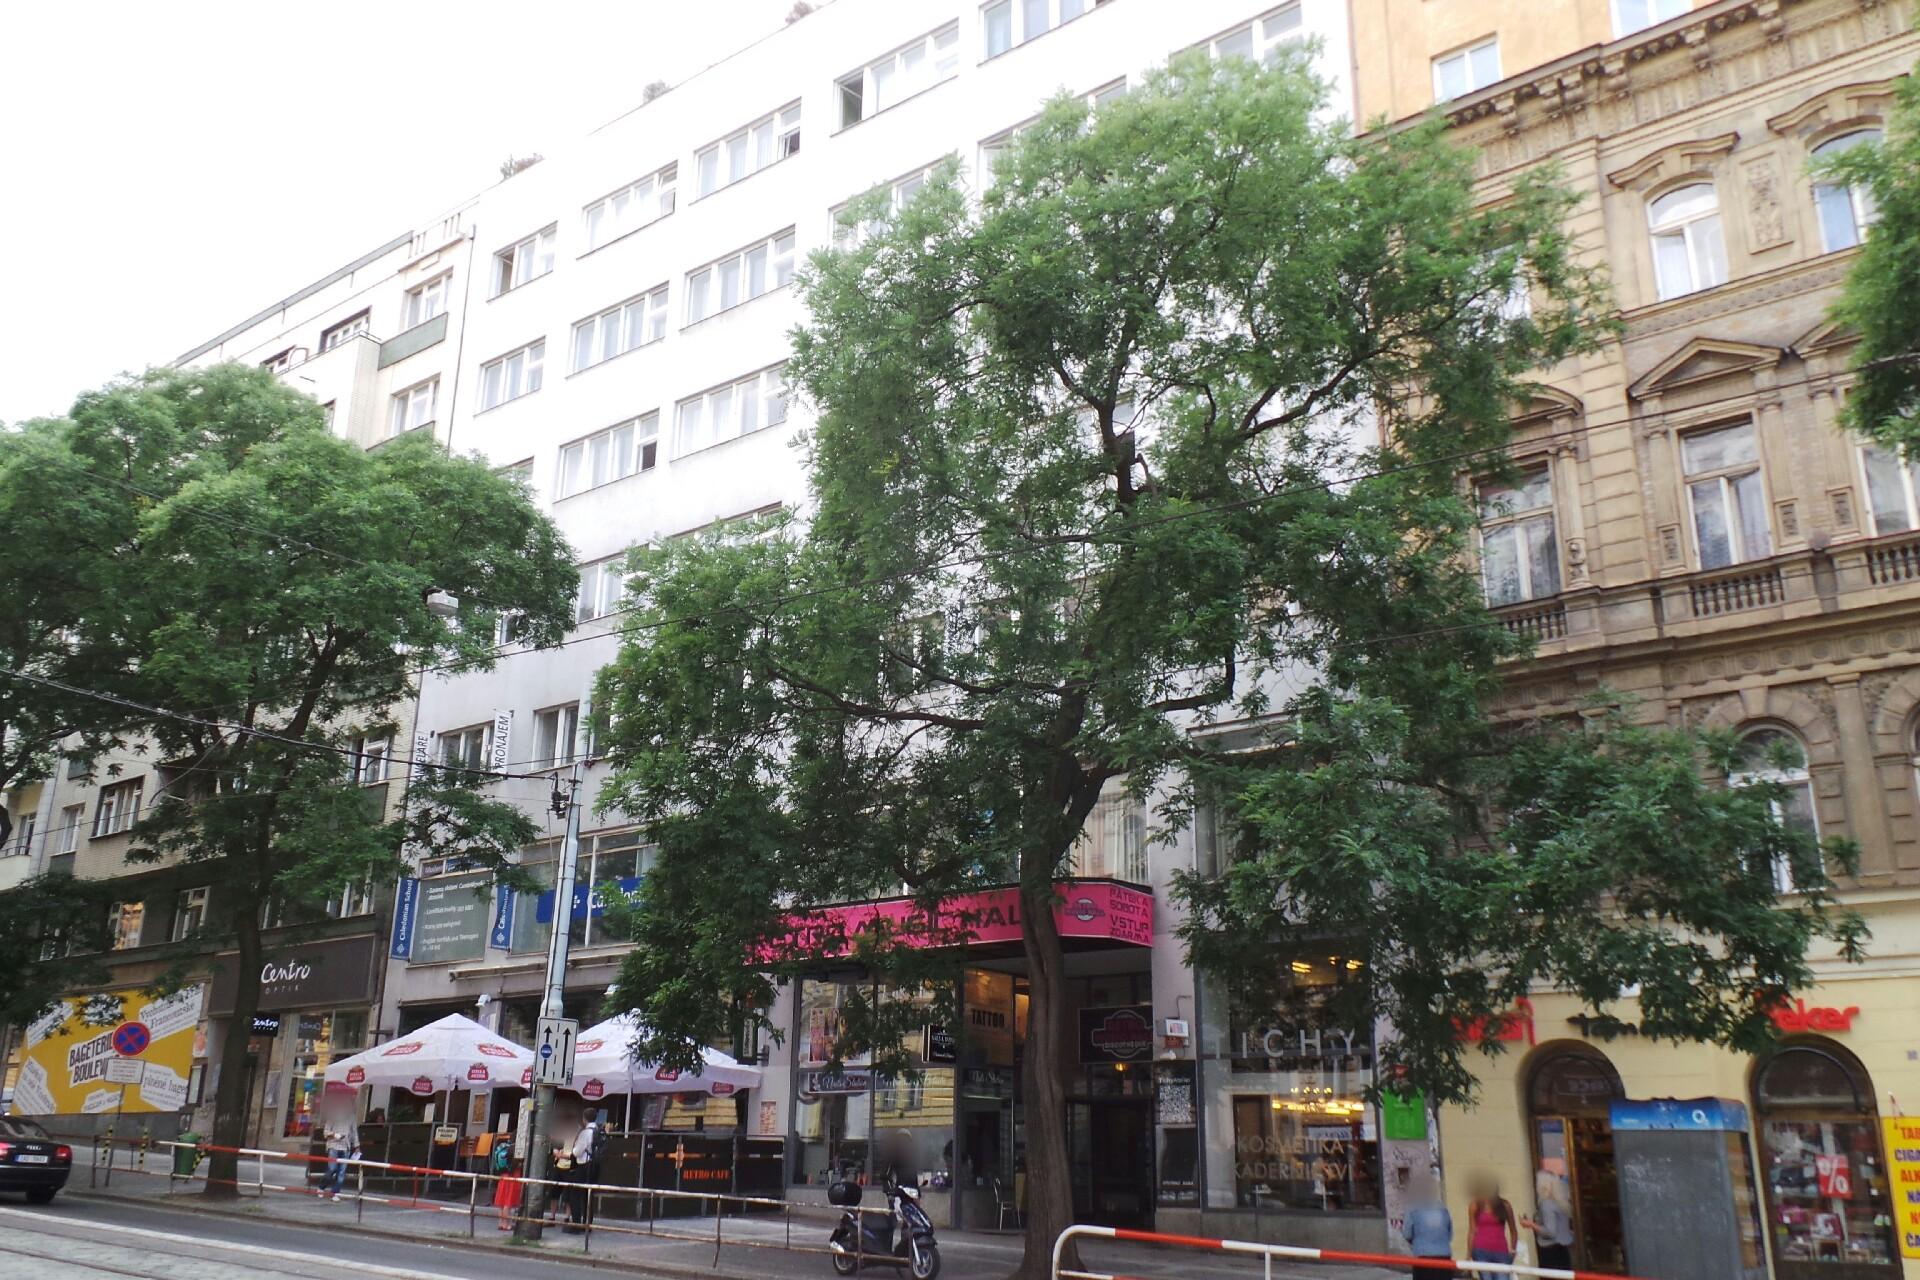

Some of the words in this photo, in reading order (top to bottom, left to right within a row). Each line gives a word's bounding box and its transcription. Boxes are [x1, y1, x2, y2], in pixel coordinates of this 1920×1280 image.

[1110, 899, 1149, 917] SOBOTA
[399, 903, 411, 941] Caledonian
[1110, 914, 1149, 933] VSTUP
[1110, 927, 1149, 943] ZDARMA
[260, 959, 311, 984] Centro
[971, 1008, 1005, 1028] TATTOO
